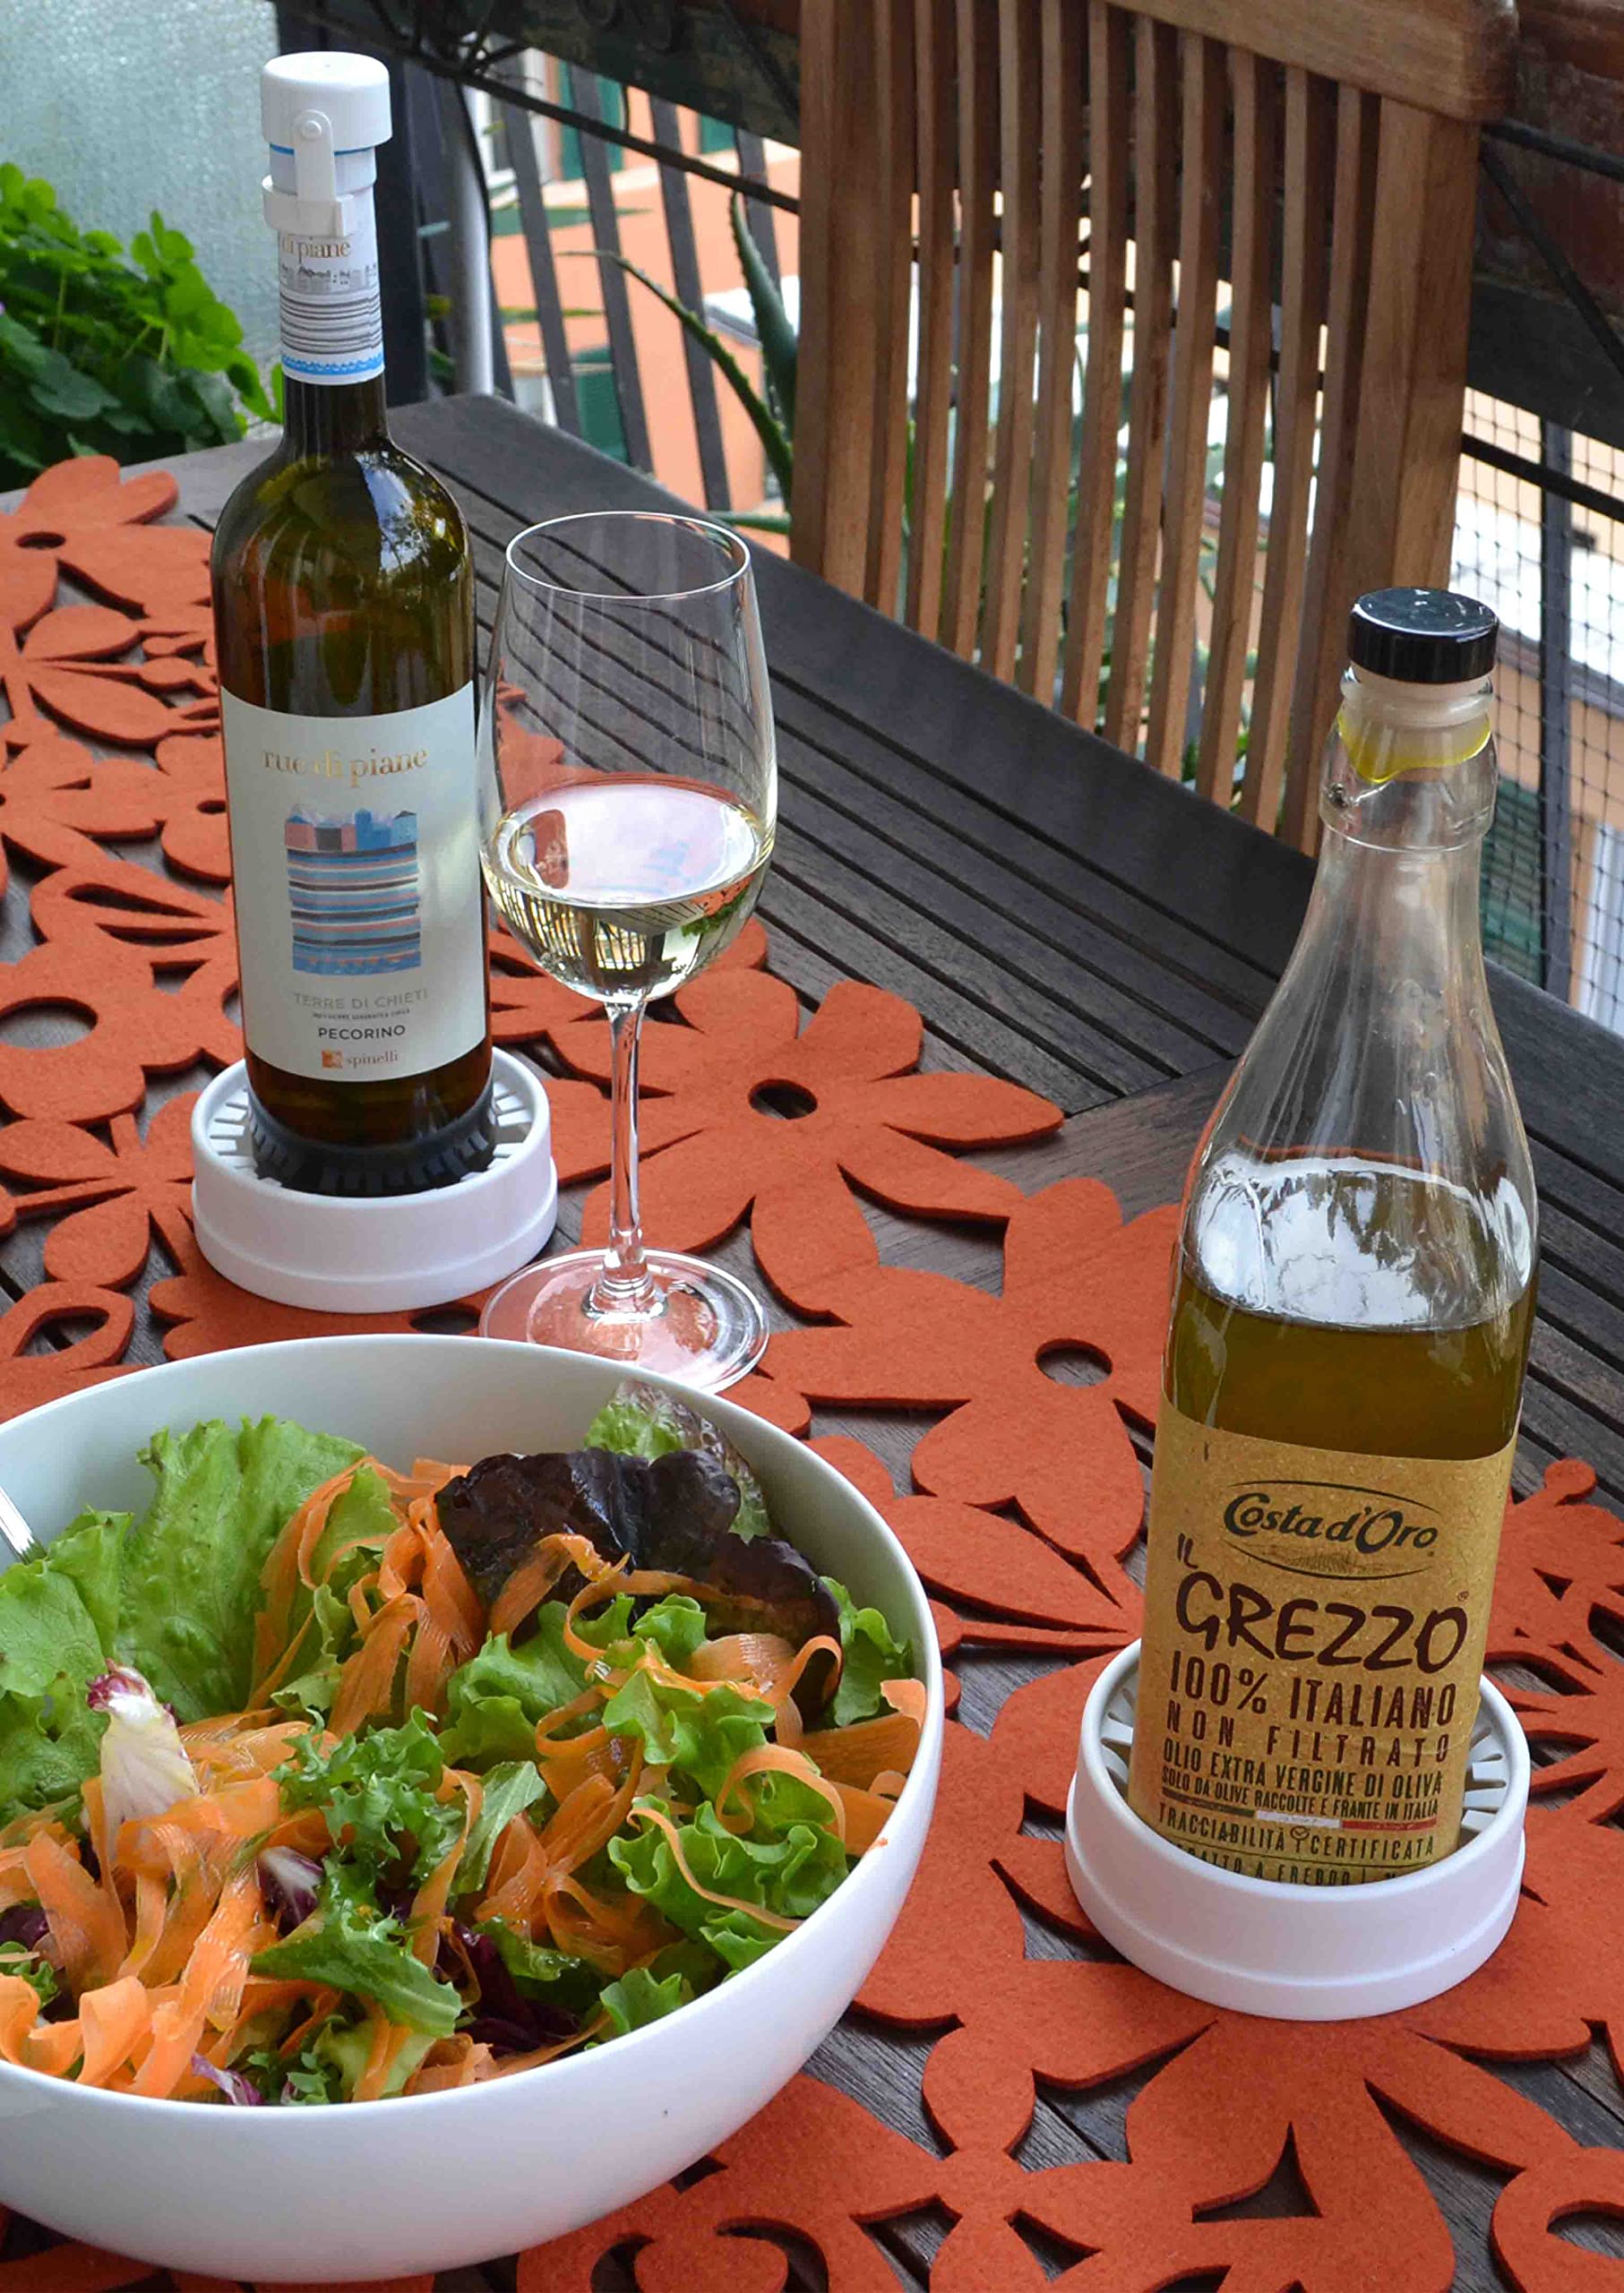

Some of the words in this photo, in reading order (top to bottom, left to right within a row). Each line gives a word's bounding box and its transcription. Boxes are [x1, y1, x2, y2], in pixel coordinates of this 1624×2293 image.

[296, 236, 350, 263] piane
[263, 750, 306, 774] rue
[314, 748, 343, 779] di
[349, 748, 429, 788] piane
[294, 992, 344, 1009] TERRE
[351, 998, 369, 1009] DI
[374, 988, 428, 1008] CHIETI
[318, 1025, 406, 1041] PECORINO
[346, 1050, 400, 1069] spinelli
[1177, 1533, 1199, 1568] IL
[1224, 1492, 1323, 1536] Costa
[1325, 1506, 1439, 1554] d'Oro
[1175, 1571, 1468, 1674] GREZZO
[1170, 1650, 1268, 1714] 100%
[1290, 1677, 1456, 1730] ITALIANO
[1166, 1699, 1234, 1748] NON
[1267, 1725, 1449, 1766] FILTRATO
[1162, 1765, 1190, 1791] SOLO
[1195, 1777, 1210, 1797] DA
[1215, 1781, 1250, 1805] OLIVE
[1254, 1790, 1315, 1815] RACCOLTE
[1320, 1798, 1329, 1816] E
[1332, 1799, 1380, 1819] FRANTE
[1385, 1802, 1399, 1820] IN
[1403, 1799, 1439, 1820] ITALIA
[1163, 1738, 1202, 1773] OLIO
[1210, 1751, 1267, 1786] EXTRA
[1276, 1764, 1356, 1797] VERGINE
[1364, 1773, 1384, 1798] DI
[1392, 1770, 1443, 1799] OLIVA
[1159, 1801, 1285, 1851] TRACCIABILITÀ
[1310, 1835, 1434, 1860] CERTIFICATA
